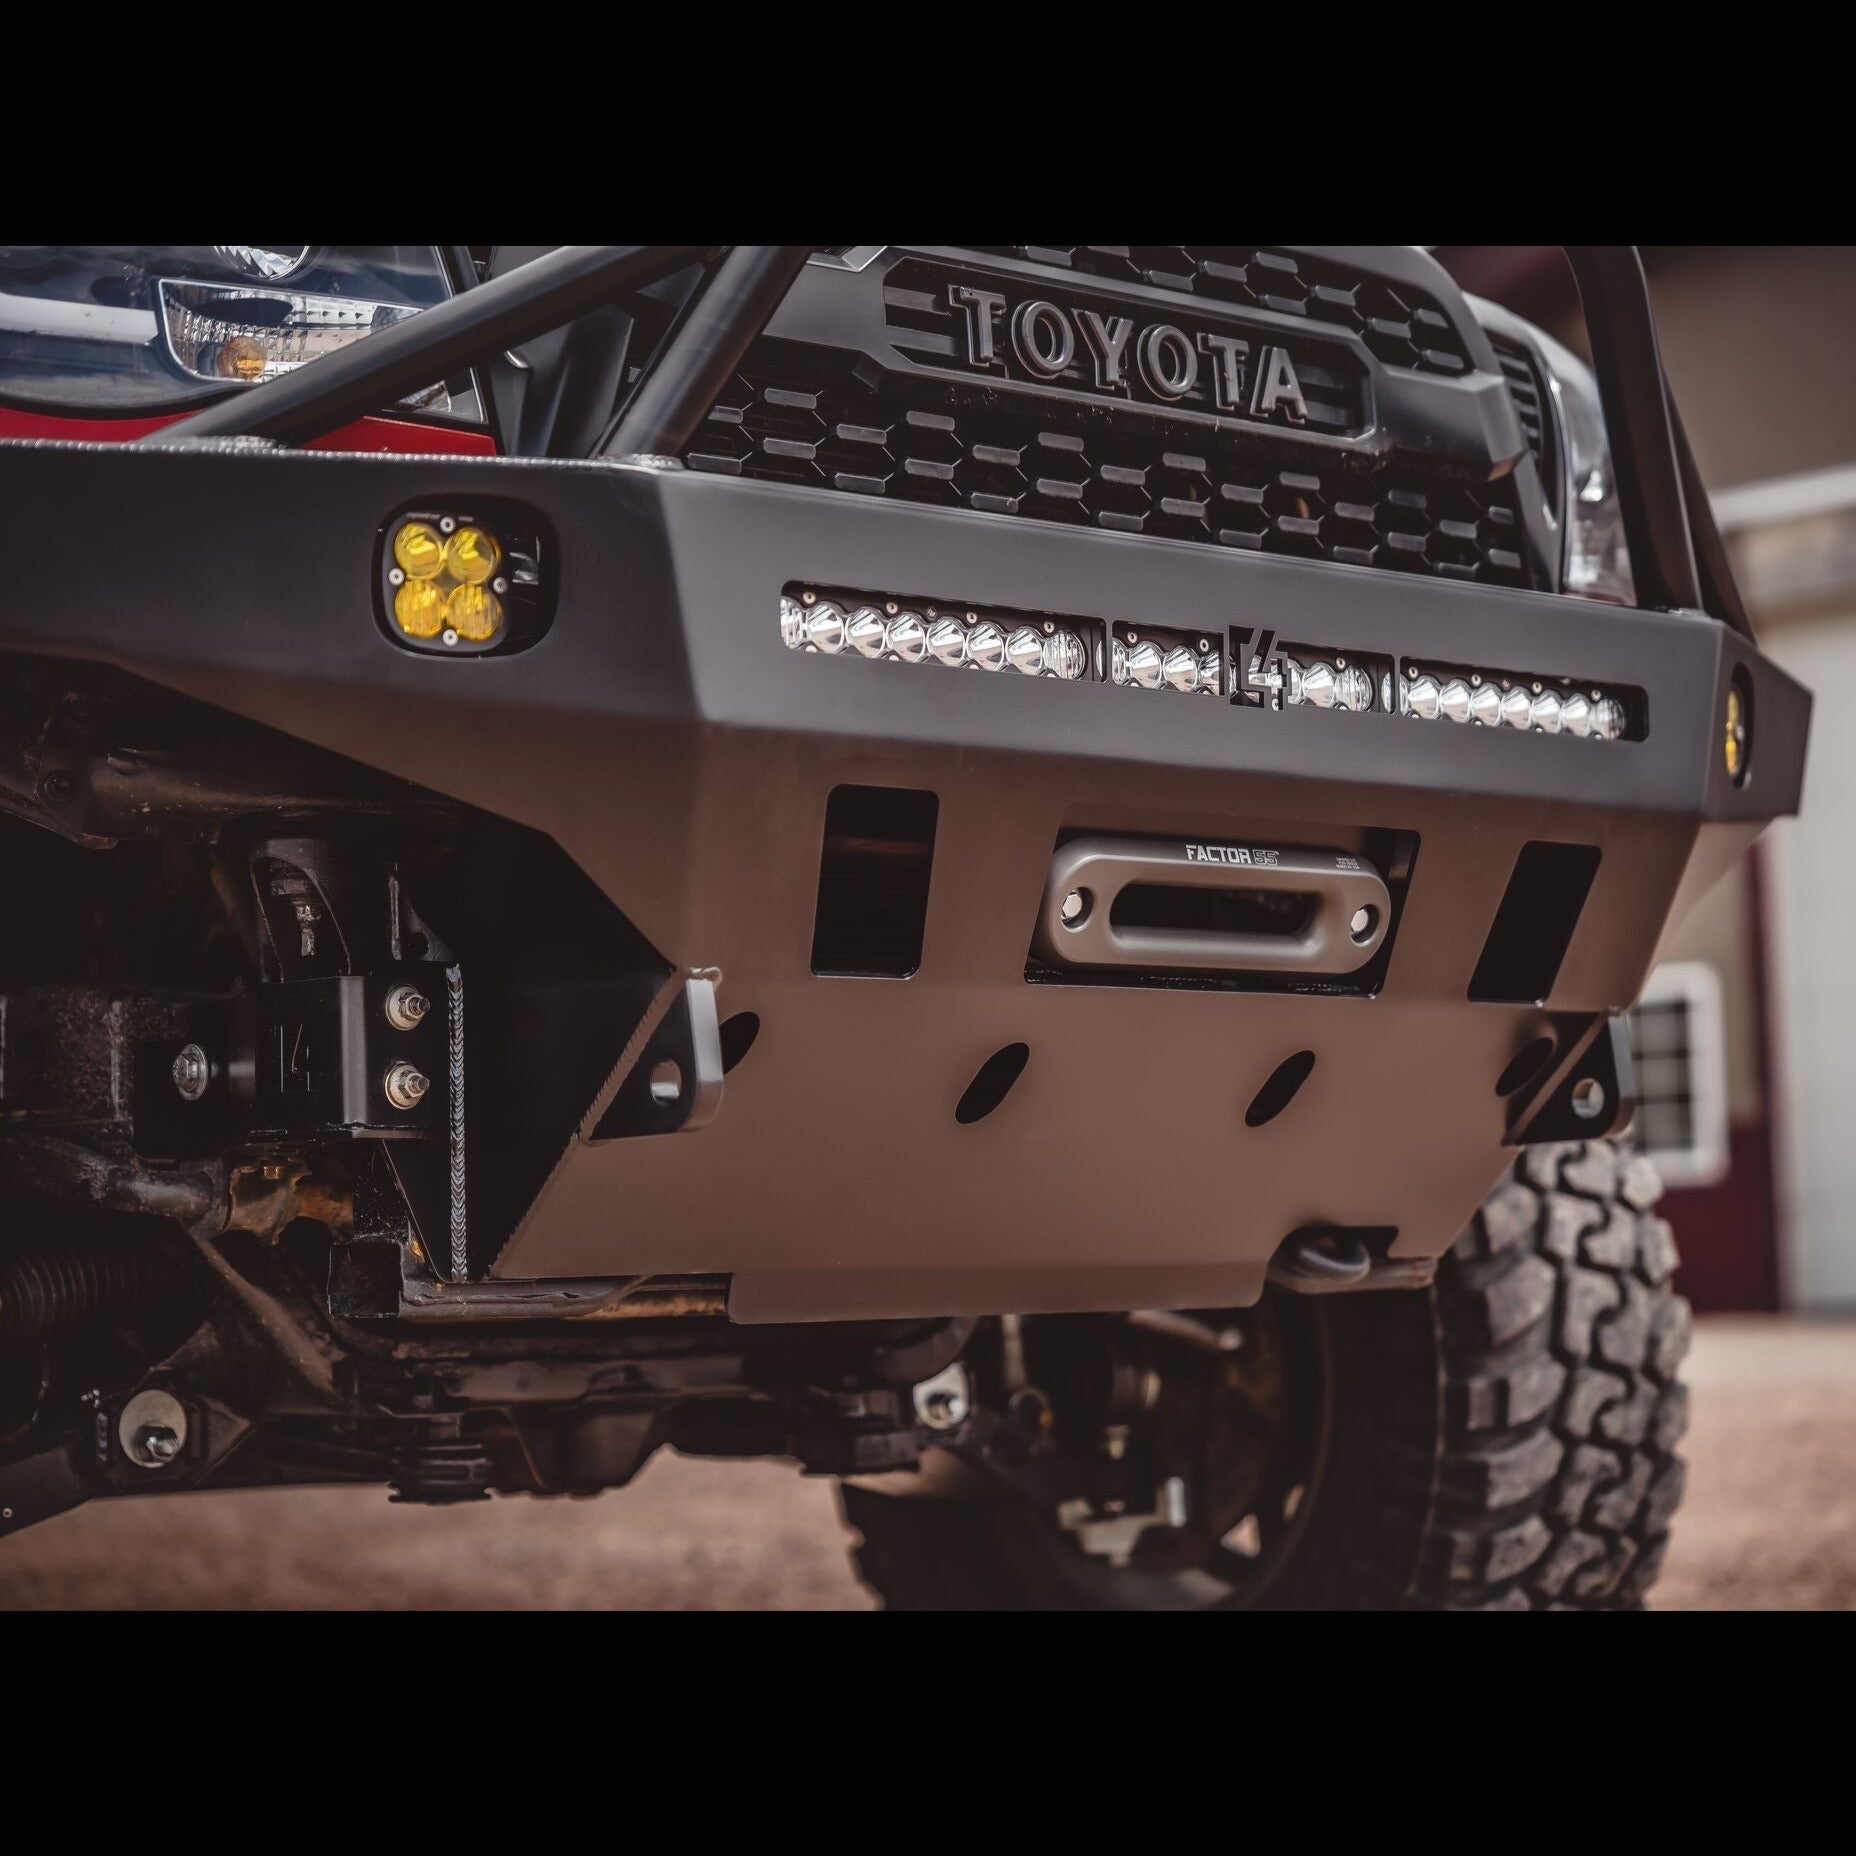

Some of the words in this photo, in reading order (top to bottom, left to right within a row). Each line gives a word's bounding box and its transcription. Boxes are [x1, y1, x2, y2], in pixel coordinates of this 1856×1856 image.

[948, 284, 1307, 424] TOYOTA
[1185, 844, 1252, 864] FACTOR
[1253, 849, 1278, 865] 55
